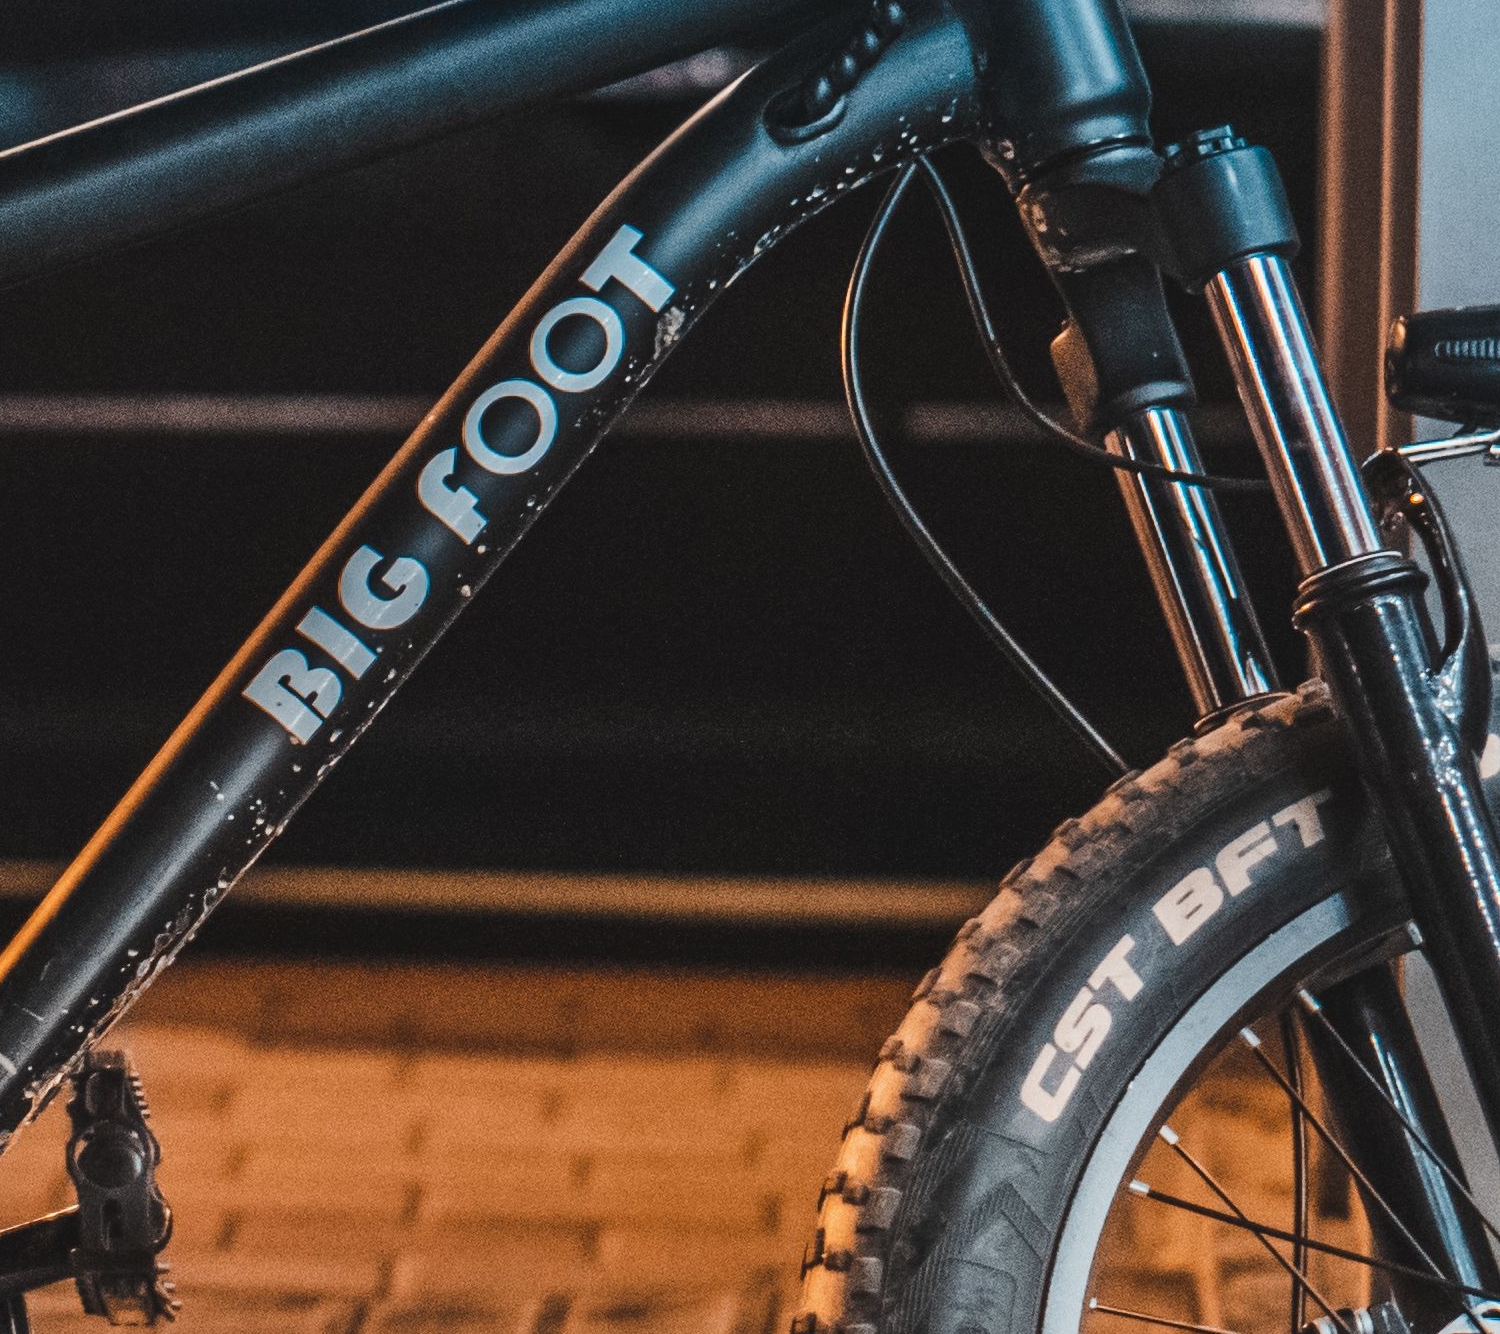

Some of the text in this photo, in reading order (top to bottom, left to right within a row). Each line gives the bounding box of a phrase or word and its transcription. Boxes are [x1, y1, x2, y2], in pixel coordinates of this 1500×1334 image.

[242, 224, 676, 745] BIG FOOT
[1019, 933, 1145, 1124] CST
[1151, 790, 1332, 946] BFT
